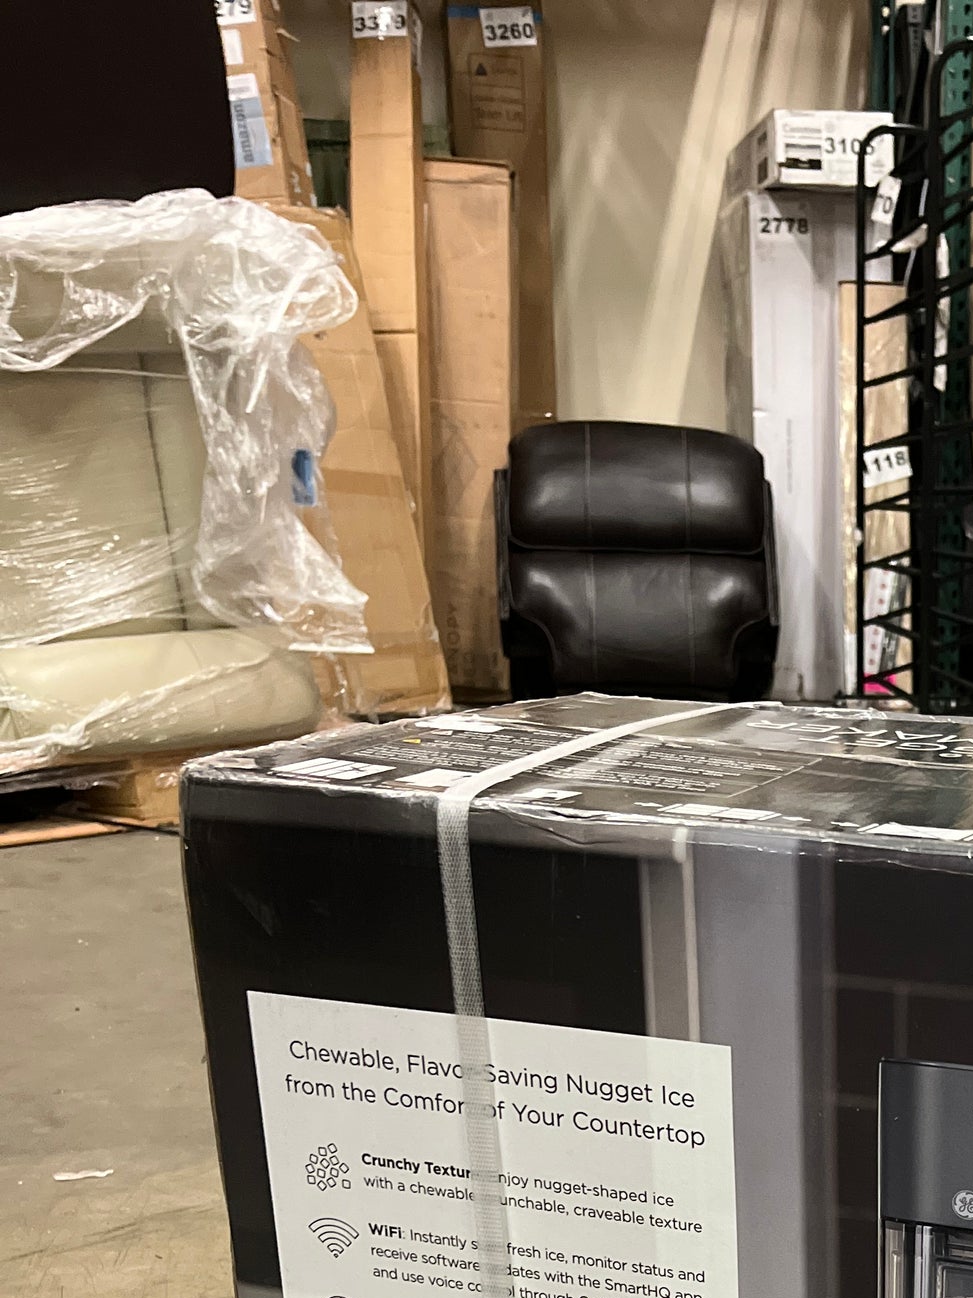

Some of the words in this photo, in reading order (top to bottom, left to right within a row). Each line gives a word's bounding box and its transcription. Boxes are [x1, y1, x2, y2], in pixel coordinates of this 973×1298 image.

[355, 14, 405, 32] 339
[485, 23, 533, 41] 3260
[234, 103, 255, 163] amazon
[761, 217, 808, 234] 2778
[289, 1039, 399, 1074] Chewable,
[566, 1072, 653, 1103] Nugget
[661, 1084, 695, 1108] Ice
[284, 1073, 334, 1098] from
[341, 1081, 376, 1103] the
[383, 1086, 467, 1114] Comfor
[511, 1102, 564, 1127] Your
[572, 1111, 705, 1149] Countertop
[360, 1152, 420, 1174] Crunchy
[423, 1160, 470, 1178] Textur
[495, 1171, 528, 1189] njoy
[533, 1178, 647, 1203] nugget-shaped
[652, 1191, 674, 1207] ice
[363, 1175, 393, 1189] with
[397, 1181, 405, 1191] a
[409, 1181, 474, 1201] chewable
[499, 1195, 569, 1216] unchable,
[573, 1205, 644, 1224] craveable
[648, 1213, 702, 1233] texture
[370, 1246, 417, 1262] receive
[421, 1253, 480, 1271] software
[505, 1263, 540, 1280] dates
[543, 1270, 574, 1285] with
[577, 1273, 600, 1288] the
[604, 1277, 671, 1298] SmartHQ
[372, 1267, 398, 1280] and
[401, 1271, 424, 1284] use
[427, 1275, 463, 1290] voice
[410, 1229, 465, 1250] Instantly
[506, 1242, 541, 1259] fresh
[544, 1247, 568, 1264] ice,
[571, 1254, 627, 1271] monitor
[631, 1261, 673, 1278] status
[677, 1270, 705, 1282] and
